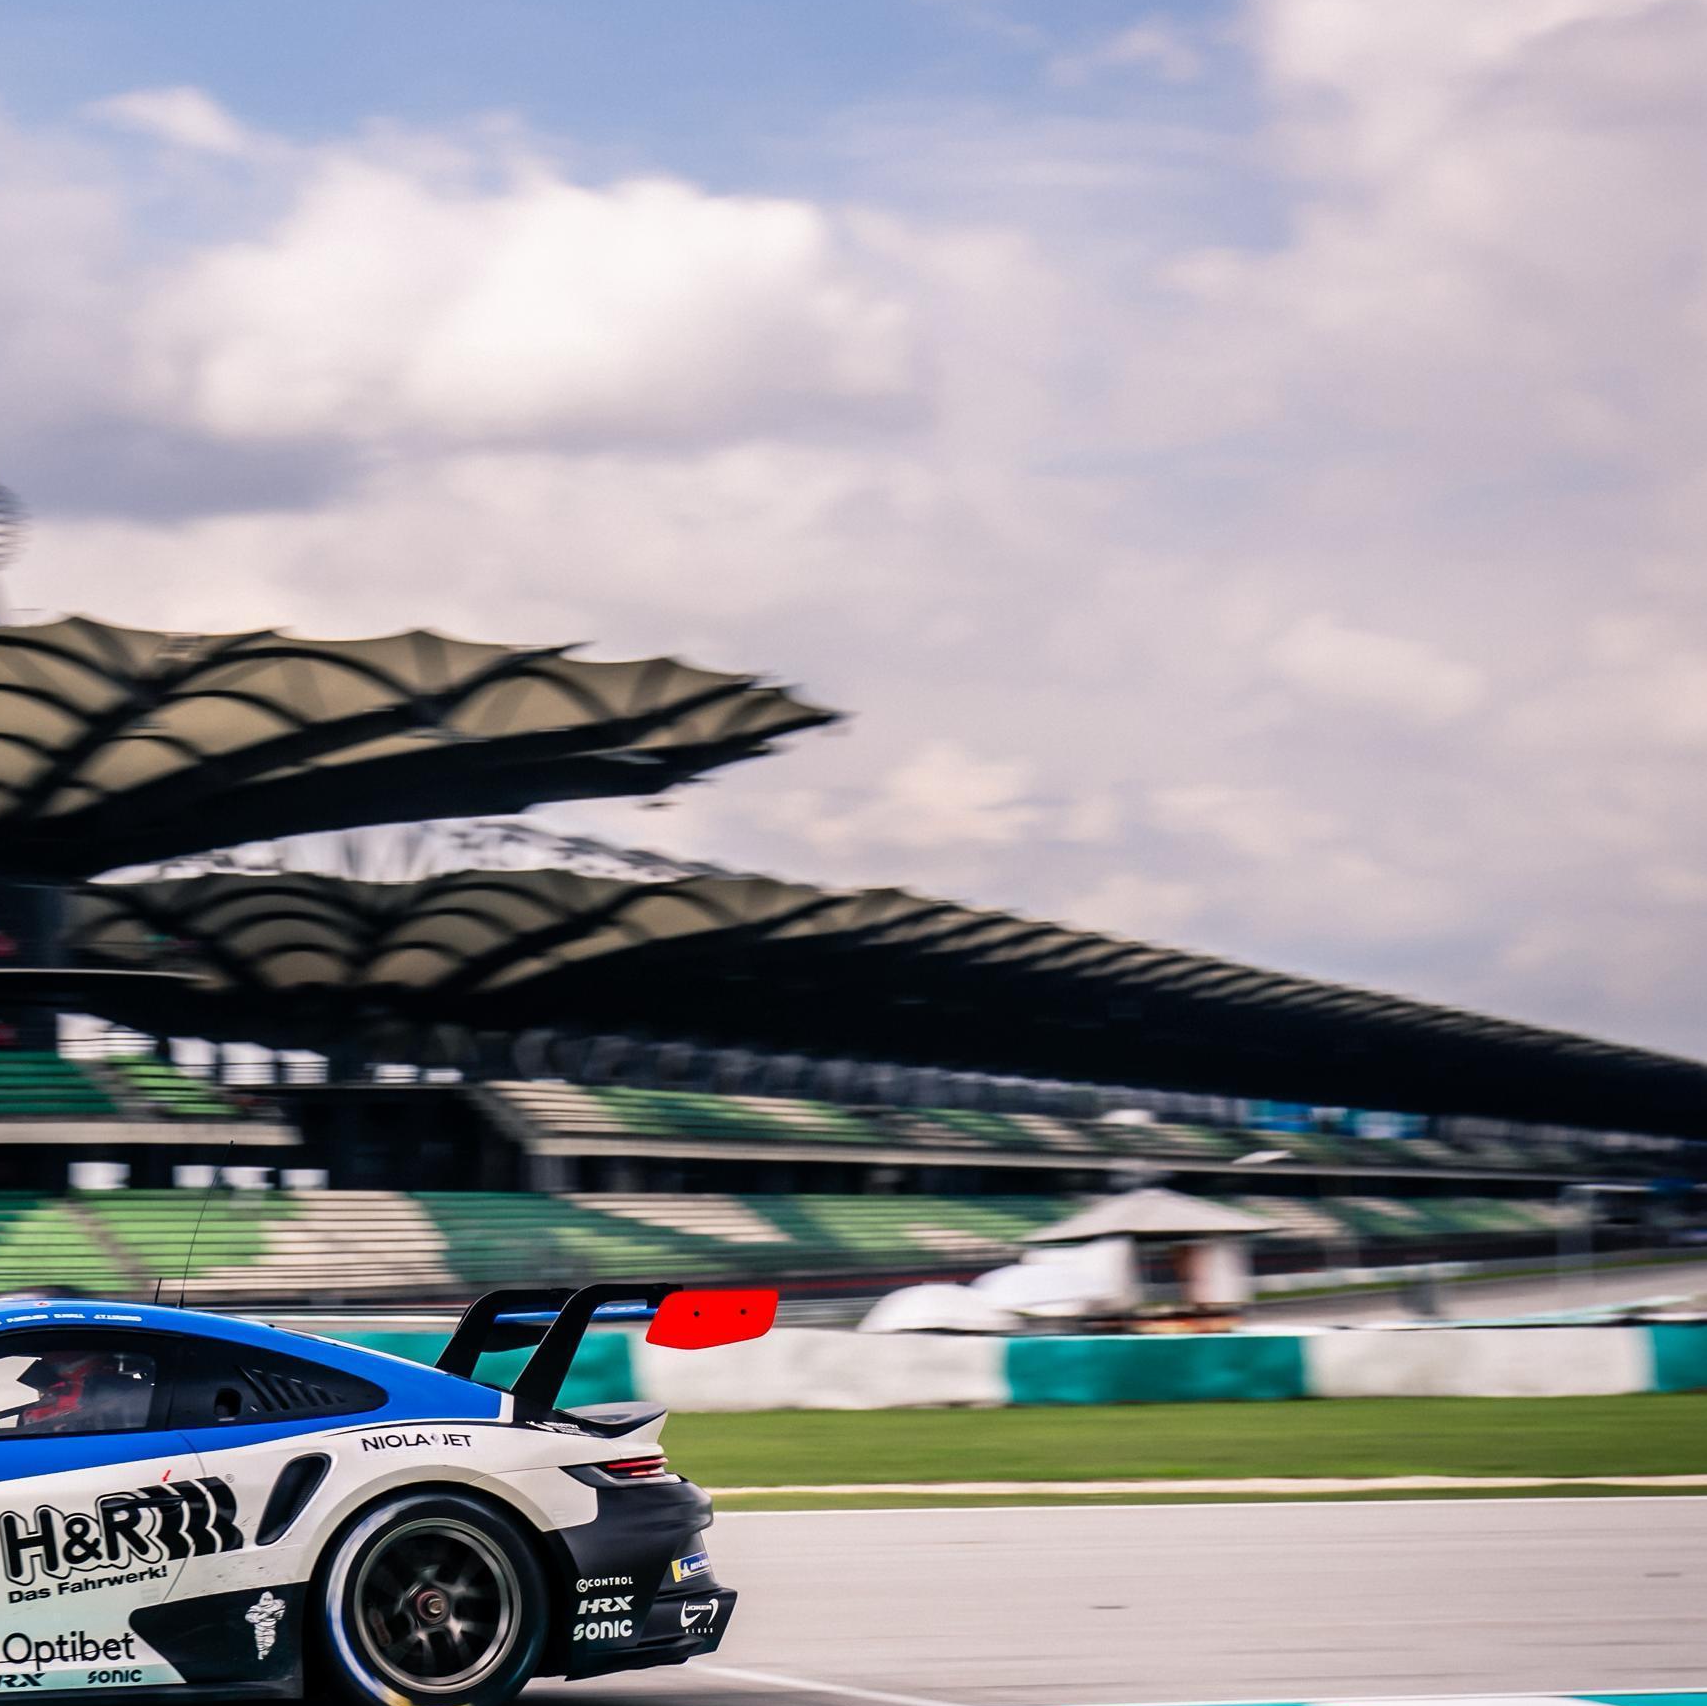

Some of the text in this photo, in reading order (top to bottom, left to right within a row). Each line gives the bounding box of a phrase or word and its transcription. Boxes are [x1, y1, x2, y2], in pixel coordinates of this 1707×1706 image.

[362, 1433, 472, 1452] NIOLA JET
[0, 1493, 159, 1583] H&R
[8, 1565, 168, 1604] Das Fahrwerk!
[577, 1595, 635, 1615] HRX
[3, 1631, 135, 1671] Optibet
